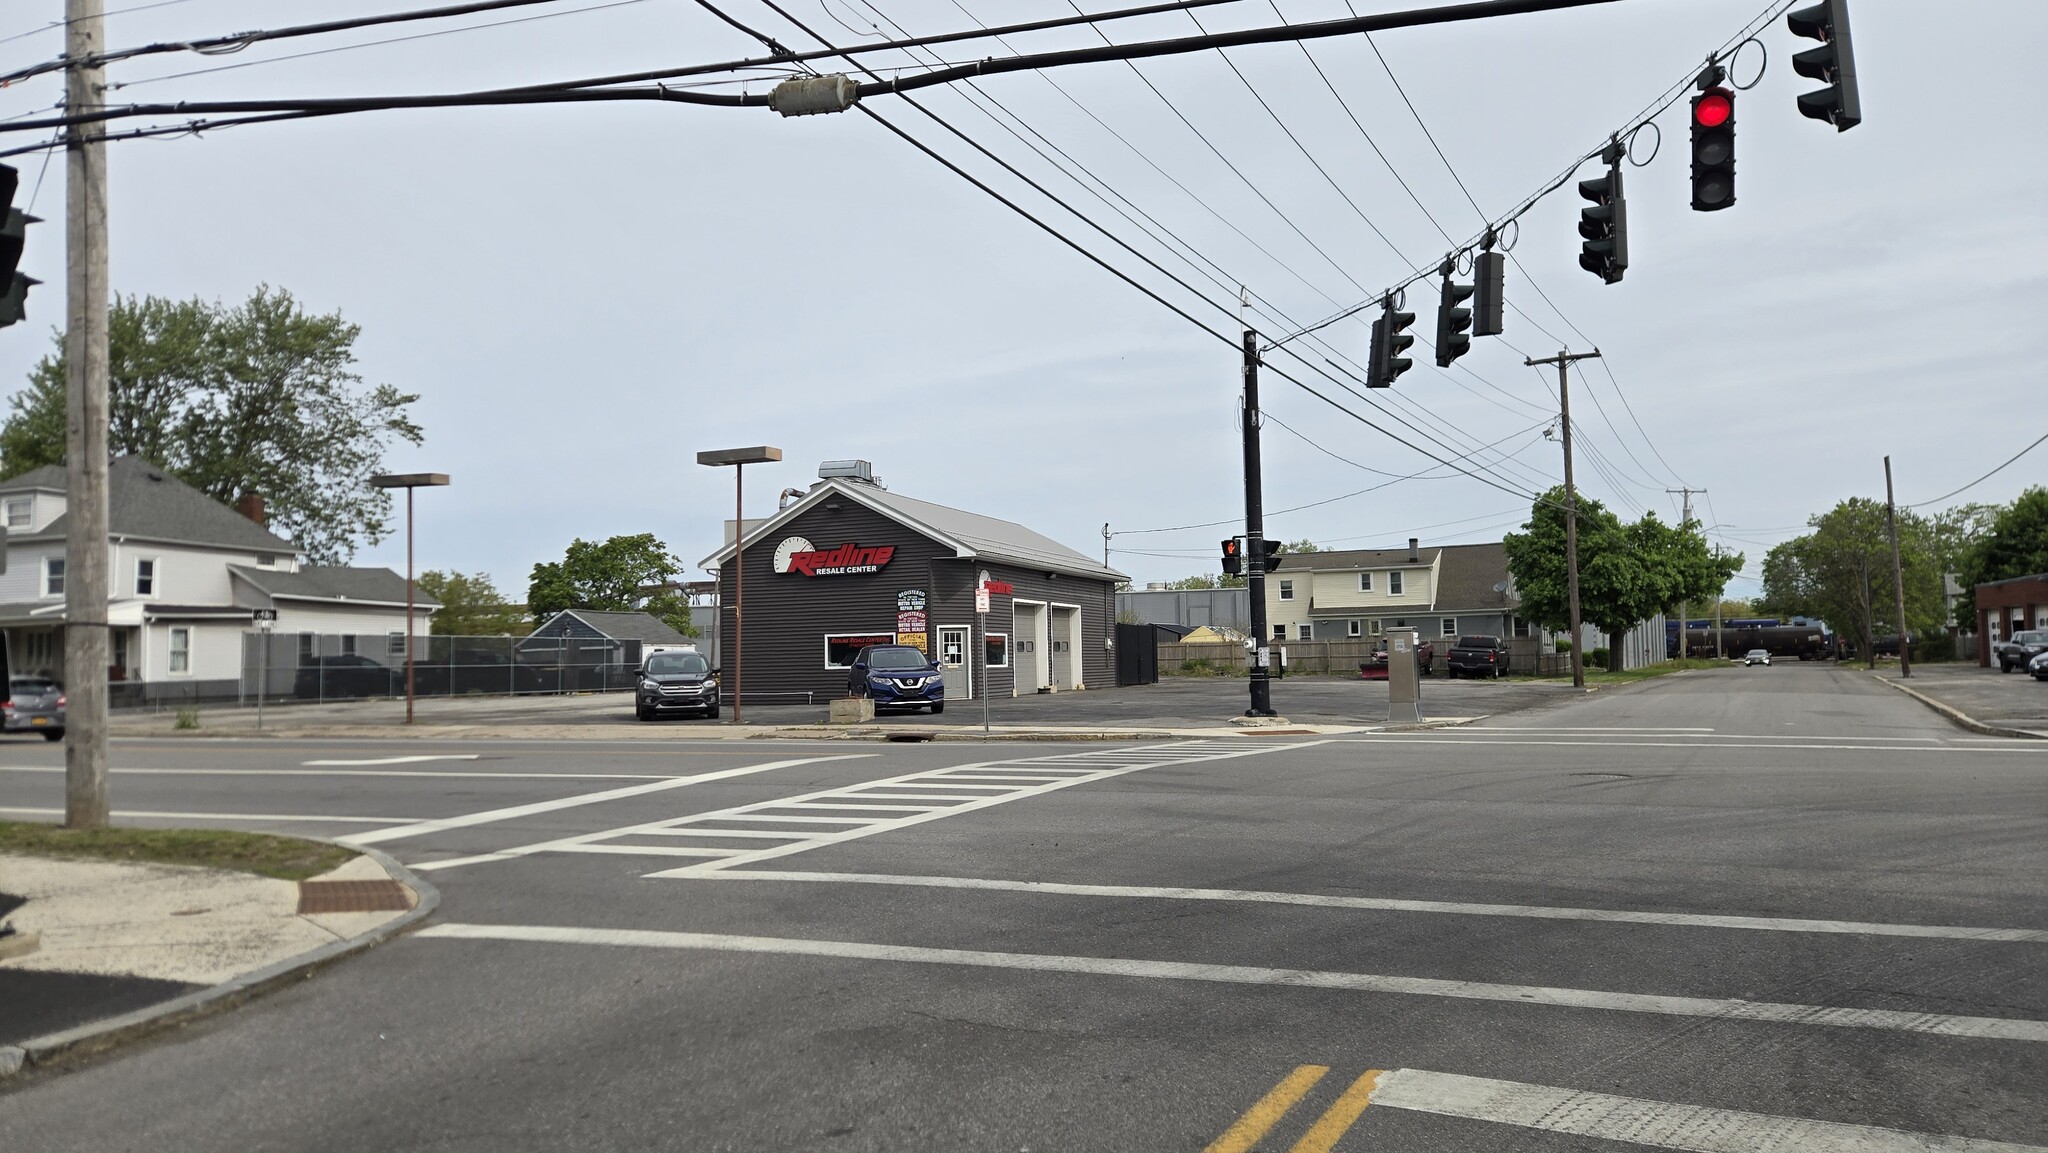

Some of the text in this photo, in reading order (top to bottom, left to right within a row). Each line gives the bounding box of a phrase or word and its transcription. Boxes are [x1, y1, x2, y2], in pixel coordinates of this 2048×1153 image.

[787, 543, 895, 577] Redline
[816, 565, 877, 575] RESALE CENTER
[898, 589, 926, 598] REGISTERED
[898, 611, 926, 620] REGISTERED
[900, 633, 925, 641] OFFICIAL
